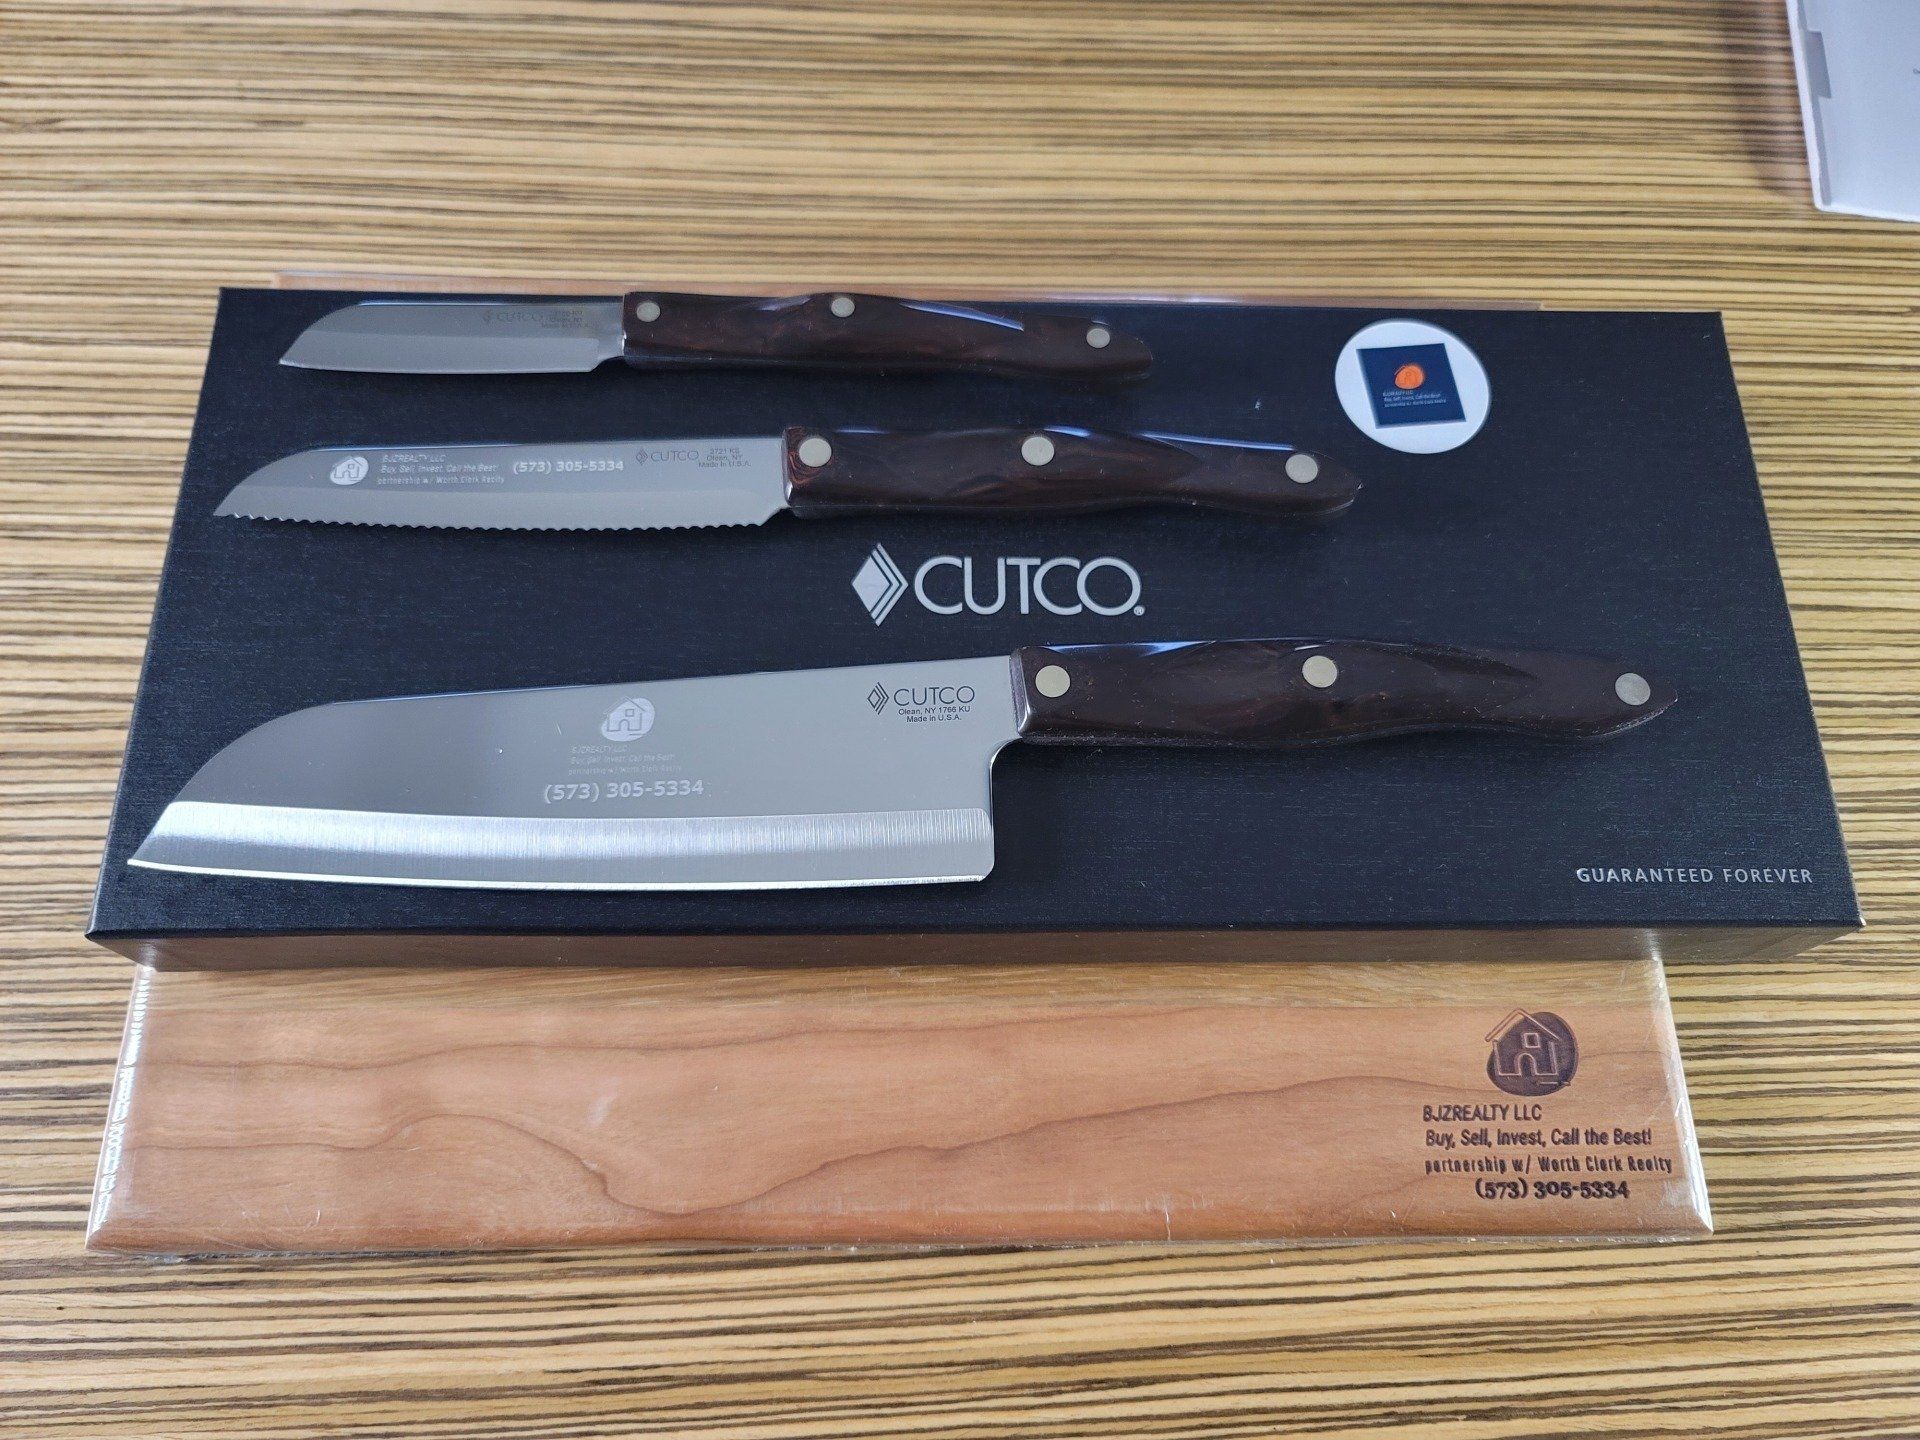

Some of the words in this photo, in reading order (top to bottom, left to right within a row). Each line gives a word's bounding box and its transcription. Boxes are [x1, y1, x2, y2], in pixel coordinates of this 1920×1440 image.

[651, 450, 699, 461] CUTCO
[513, 460, 551, 475] (573)
[556, 460, 624, 473] 305-5334
[914, 555, 1142, 616] CUTCO
[893, 685, 975, 707] CUTCO
[906, 715, 927, 723] Made
[929, 714, 936, 722] in
[544, 783, 600, 804] (573)
[606, 780, 704, 798] 305-5334
[1576, 868, 1713, 883] GUARANTEED
[1722, 867, 1813, 883] FOREVER
[1423, 1104, 1509, 1122] BJZREALTY
[1514, 1104, 1542, 1121] LLC
[1425, 1129, 1456, 1150] Buy,
[1460, 1128, 1492, 1148] Sell,
[1497, 1128, 1546, 1148] Invest,
[1550, 1128, 1579, 1145] Call
[1584, 1128, 1609, 1145] the
[1613, 1127, 1652, 1145] Best!
[1425, 1156, 1507, 1175] partnership
[1512, 1154, 1531, 1174] w/
[1538, 1155, 1580, 1172] Worth
[1627, 1155, 1672, 1174] Realty
[1475, 1177, 1529, 1199] (573)
[1533, 1180, 1631, 1199] 305-5334
